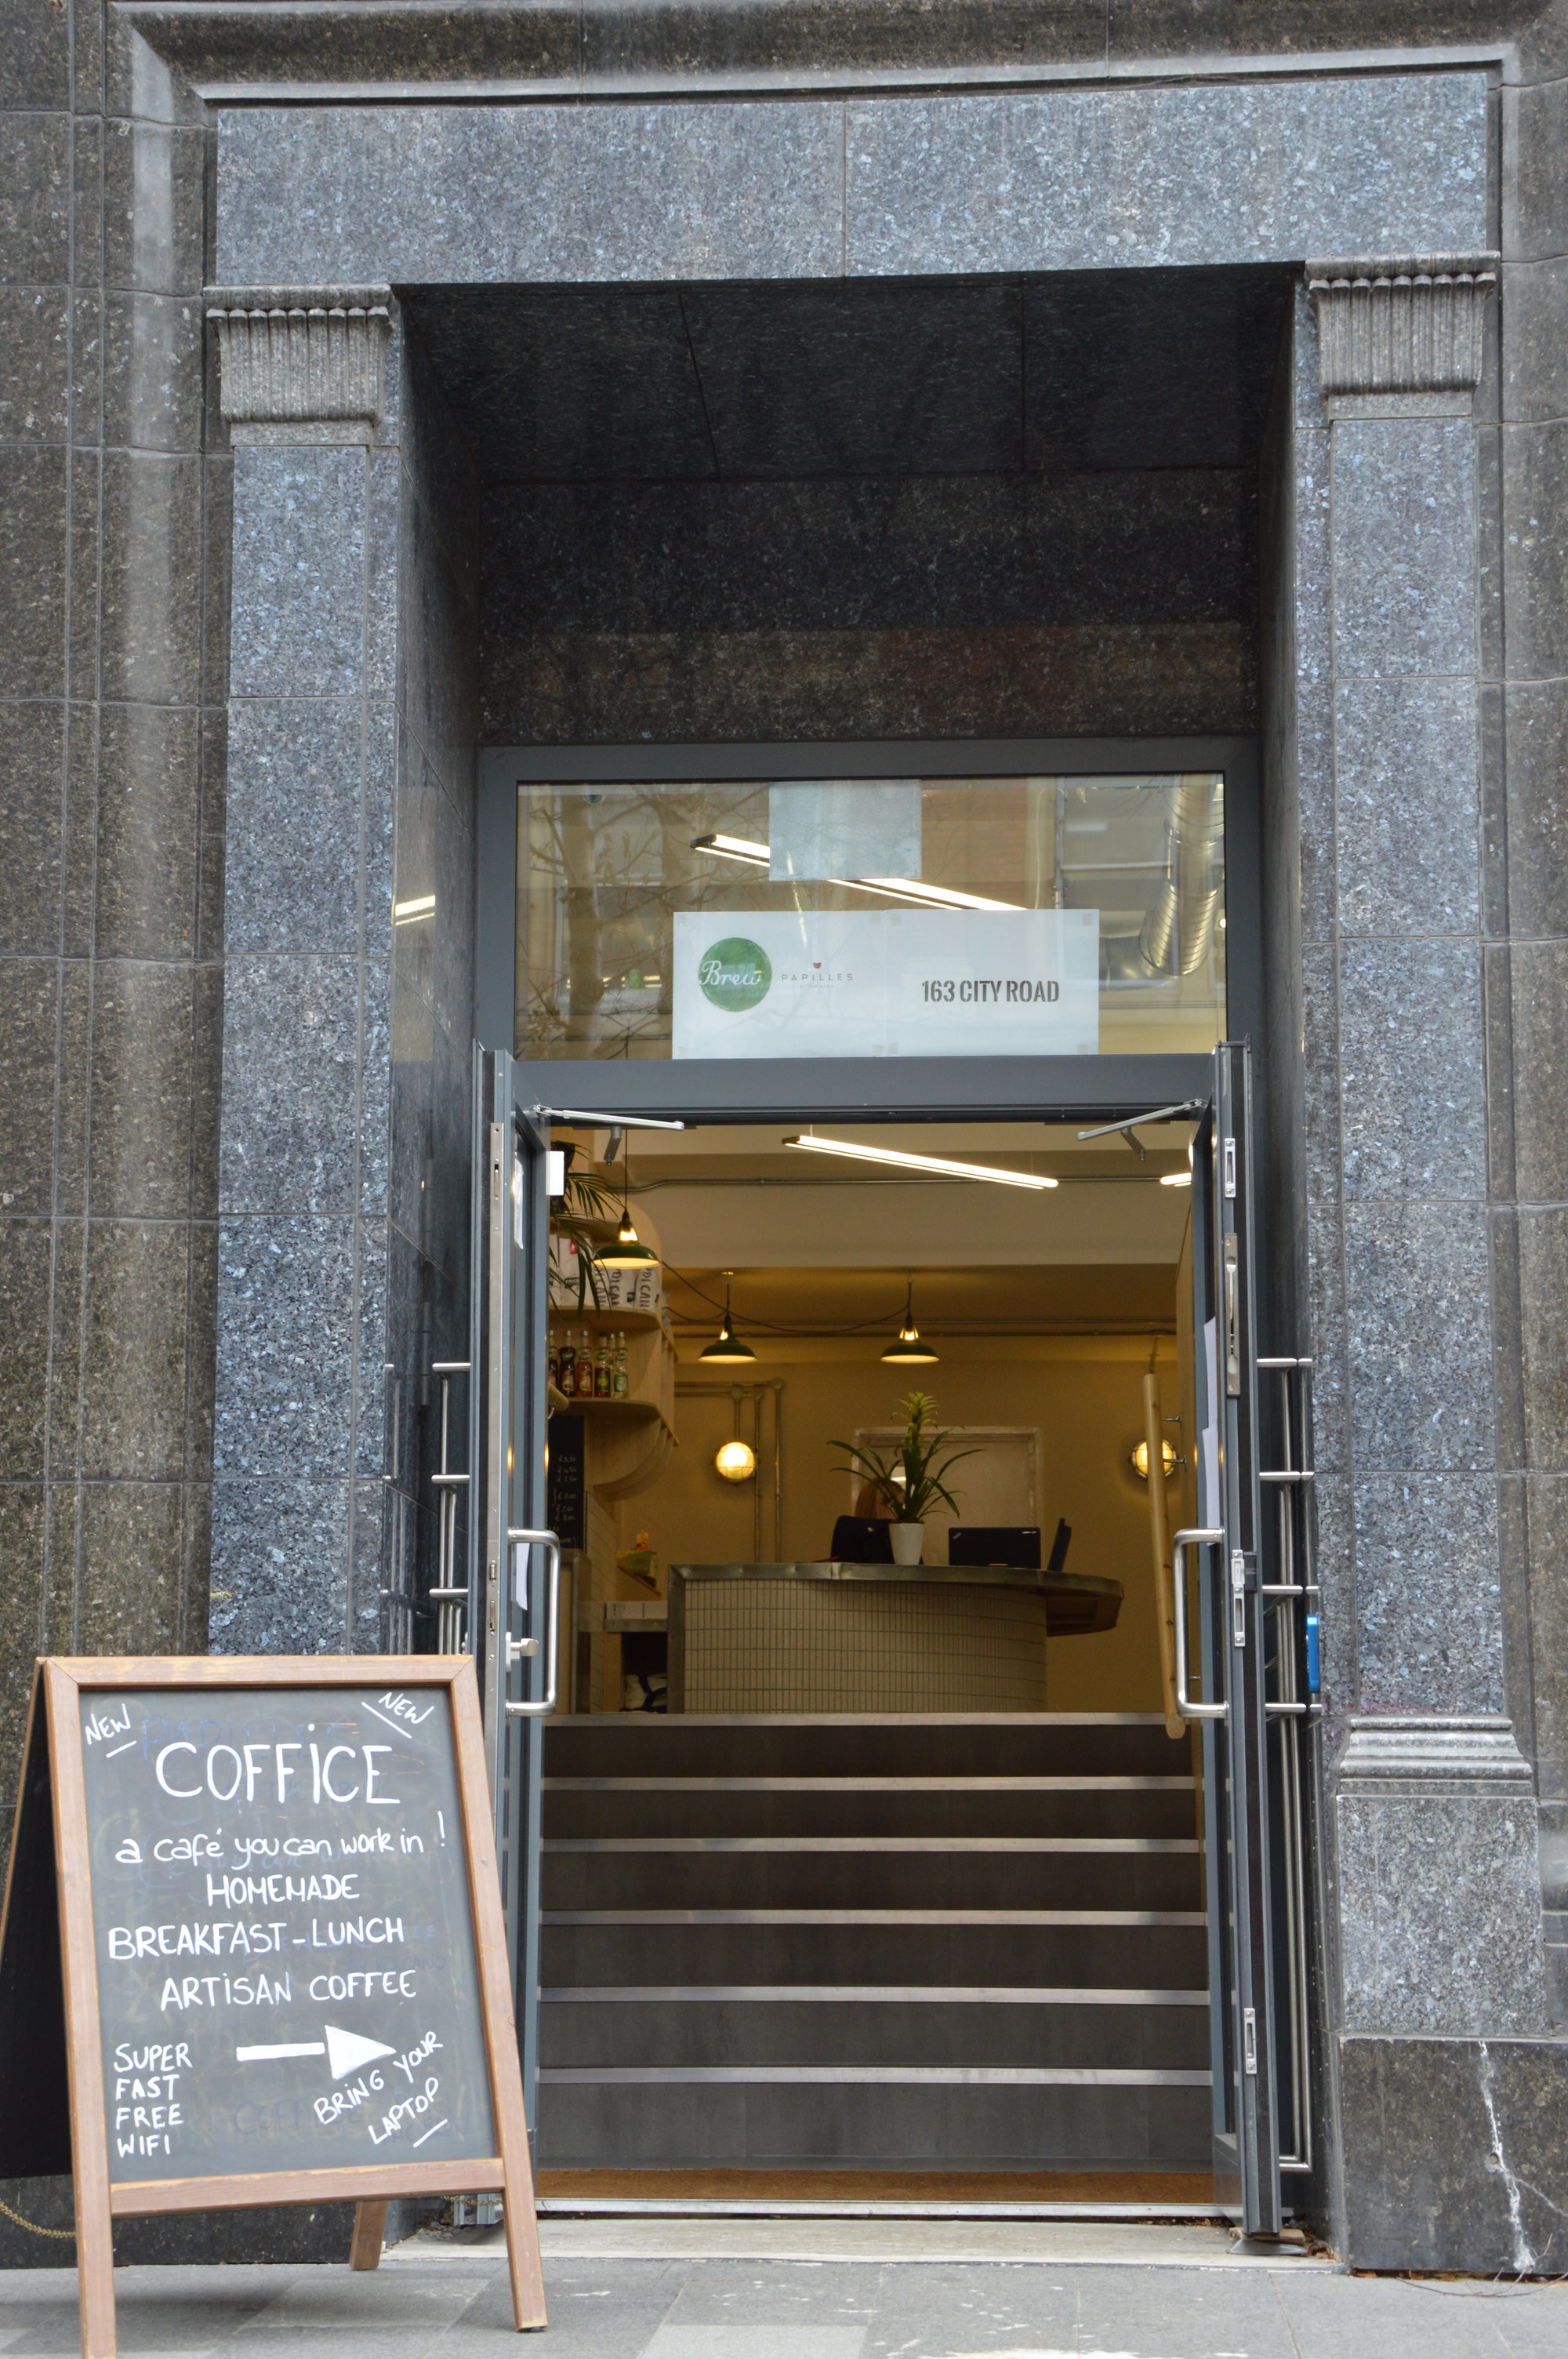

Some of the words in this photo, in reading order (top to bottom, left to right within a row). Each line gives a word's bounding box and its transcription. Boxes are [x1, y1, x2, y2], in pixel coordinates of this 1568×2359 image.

[698, 960, 761, 986] Brew
[922, 980, 955, 1002] 163
[960, 980, 1002, 1002] CITY
[1006, 980, 1059, 1002] ROAD
[85, 1703, 132, 1745] NEW
[379, 1692, 435, 1725] NEW
[115, 1838, 143, 1863] a
[153, 1827, 224, 1864] café
[234, 1838, 280, 1870] you
[281, 1837, 332, 1857] can
[340, 1826, 395, 1854] work
[206, 1873, 361, 1909] HOMEMADE
[108, 1921, 287, 1961] BREAKFAST
[309, 1969, 417, 2001] COFFEE
[114, 2042, 193, 2073] SUPER
[392, 2030, 444, 2083] YOUR
[115, 2074, 180, 2101] FAST
[116, 2103, 184, 2130] FREE
[368, 2077, 440, 2145] LAPTOP
[118, 2134, 171, 2158] WIFI
